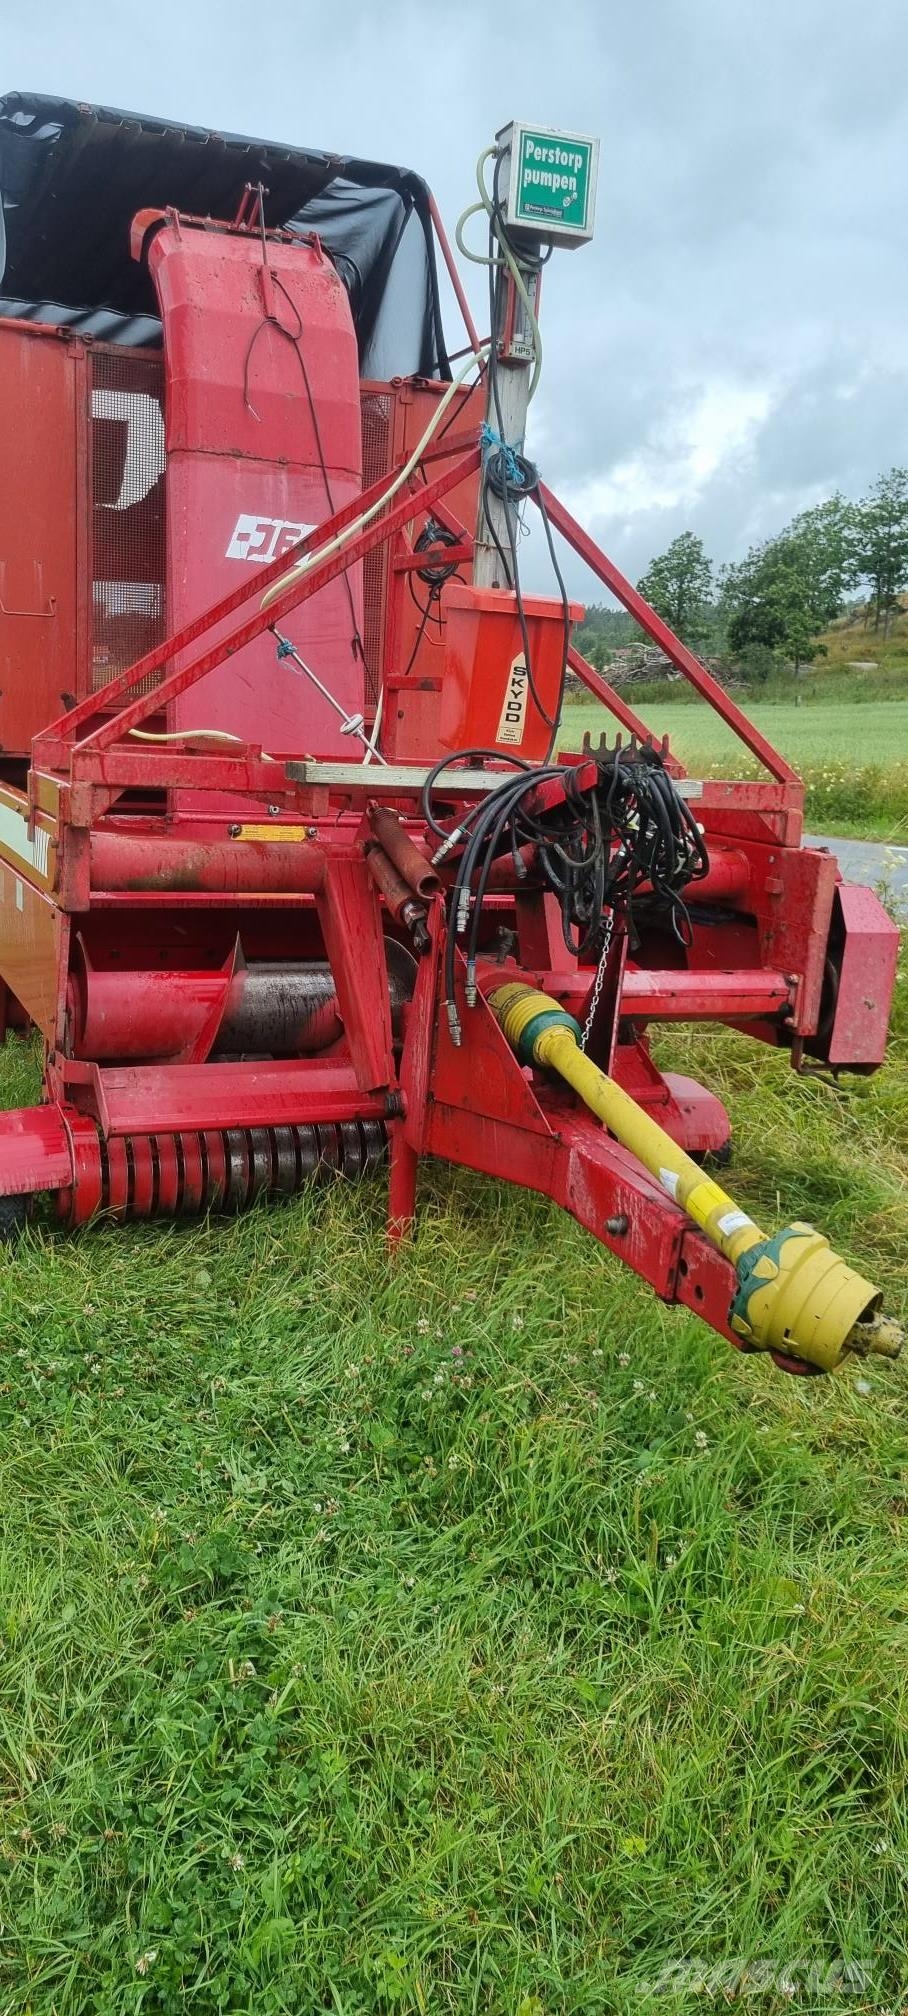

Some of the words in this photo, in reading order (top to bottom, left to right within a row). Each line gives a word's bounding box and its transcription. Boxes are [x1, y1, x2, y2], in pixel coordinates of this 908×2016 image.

[525, 140, 583, 174] Perstorp
[523, 168, 577, 193] pumpen
[505, 666, 527, 723] SKYDD
